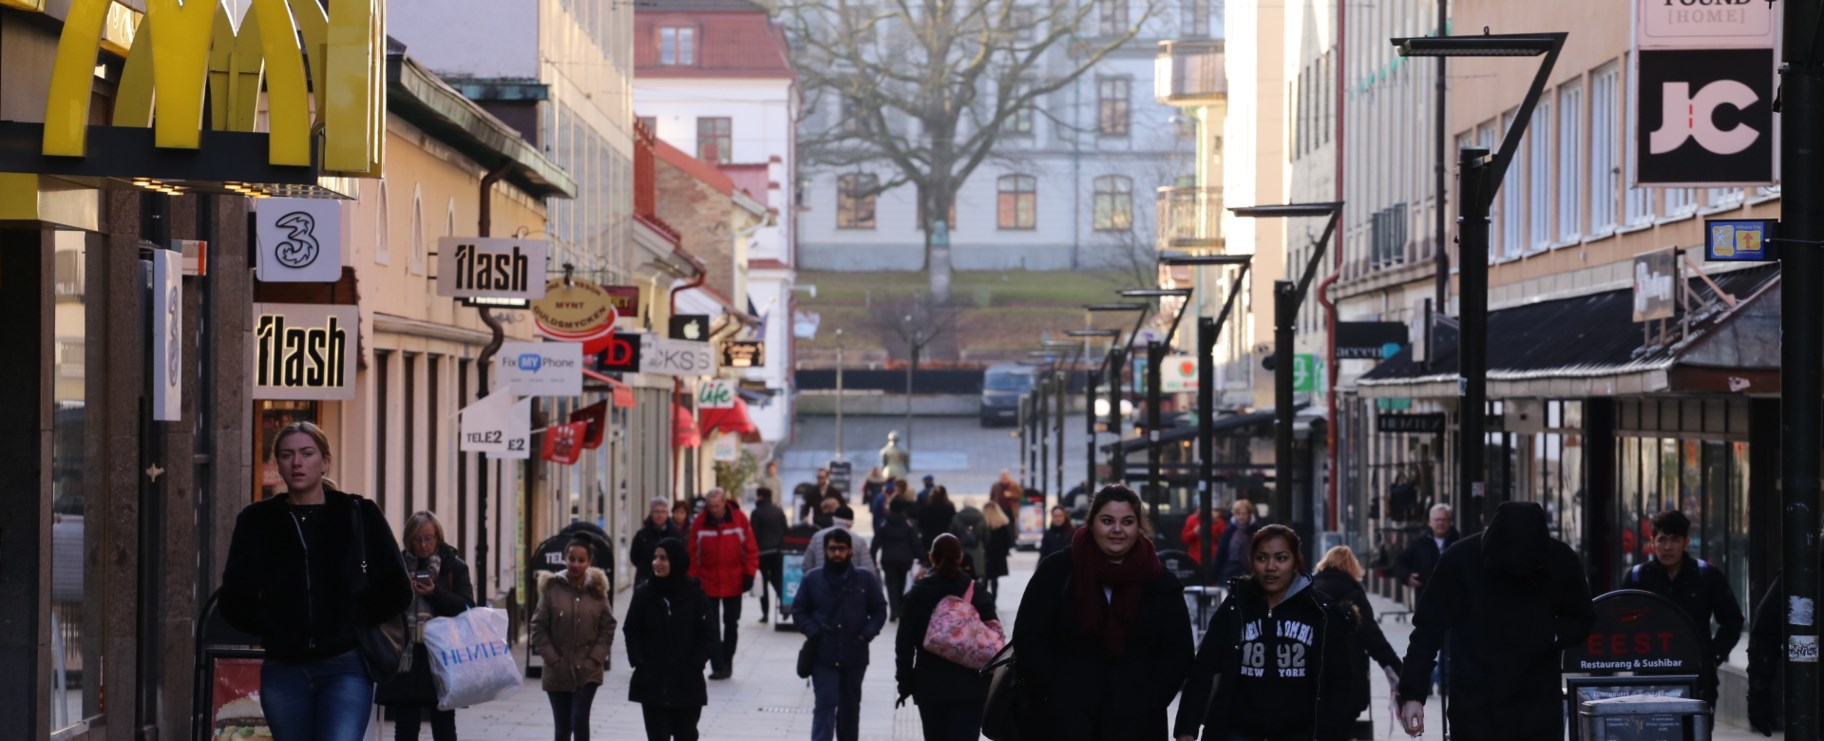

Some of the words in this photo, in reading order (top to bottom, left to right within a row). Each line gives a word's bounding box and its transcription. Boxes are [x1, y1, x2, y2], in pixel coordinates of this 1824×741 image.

[1650, 79, 1760, 155] JC
[274, 211, 320, 269] 3
[455, 244, 528, 292] flash
[555, 301, 585, 310] MYNT
[256, 315, 346, 388] flash
[502, 356, 516, 368] Fix
[521, 357, 538, 368] MY
[543, 356, 575, 368] Phone
[466, 430, 503, 445] TELE2
[1587, 632, 1674, 655] EEST
[1241, 666, 1264, 677] NEW
[1279, 668, 1306, 677] YORK
[1580, 660, 1632, 669] Restaurang
[1633, 659, 1642, 668] &
[1642, 658, 1683, 668] Sushibar
